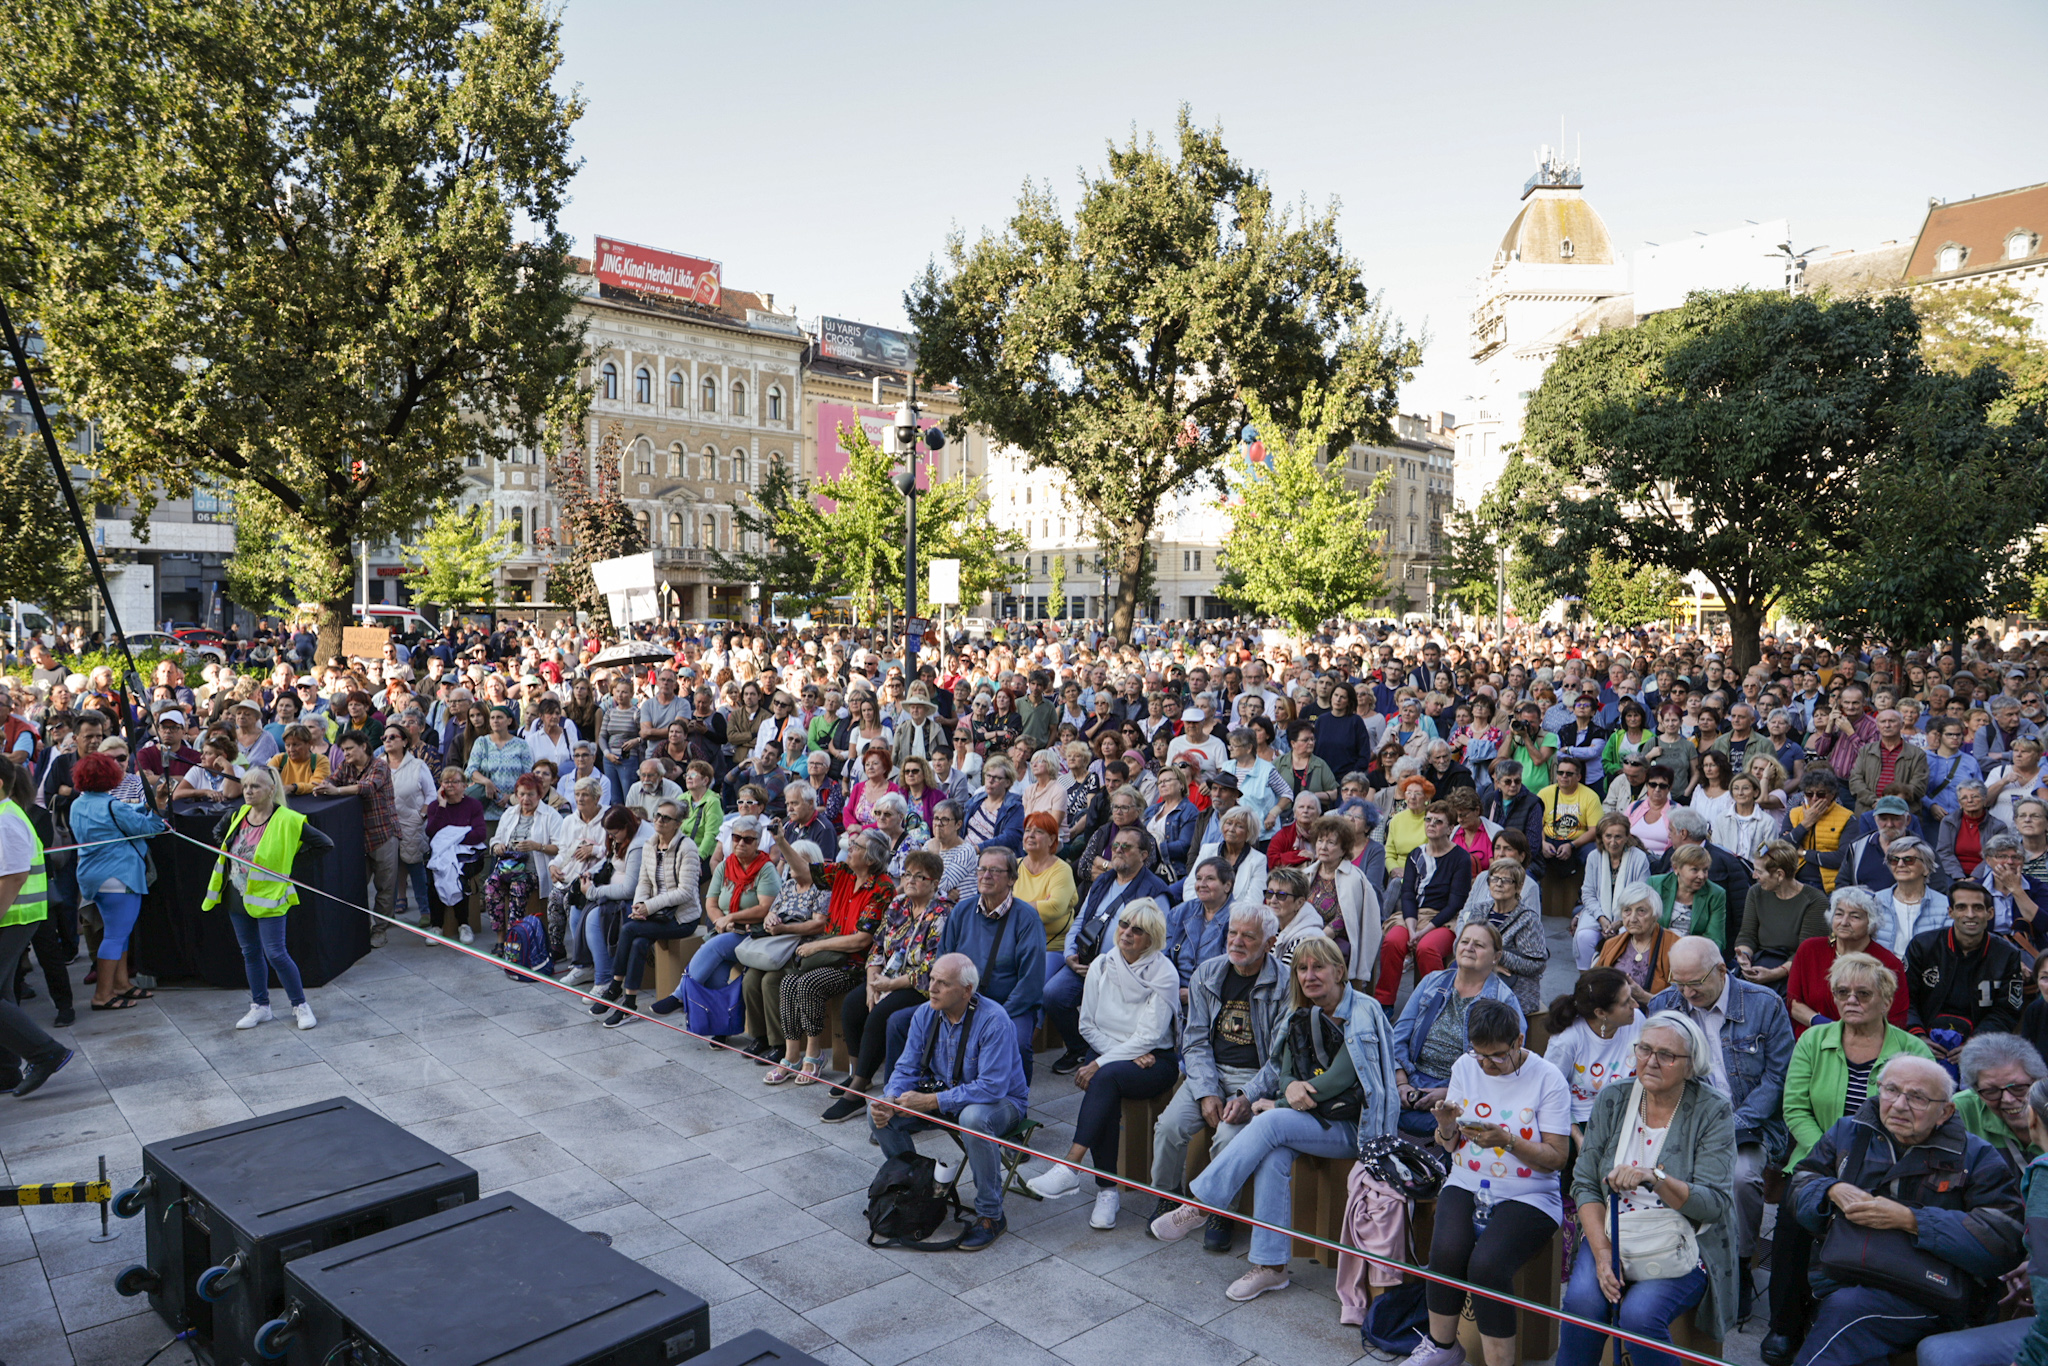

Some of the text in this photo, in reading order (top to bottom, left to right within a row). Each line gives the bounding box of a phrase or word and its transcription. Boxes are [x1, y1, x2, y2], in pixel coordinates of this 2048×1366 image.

[645, 262, 674, 285] Herbál
[621, 279, 674, 295] www.jing.hu
[825, 319, 861, 337] ÚJ YARIS
[825, 333, 854, 347] CROSS
[825, 344, 857, 359] HYBRID
[197, 512, 210, 522] 06
[1978, 980, 2001, 1007] 1
